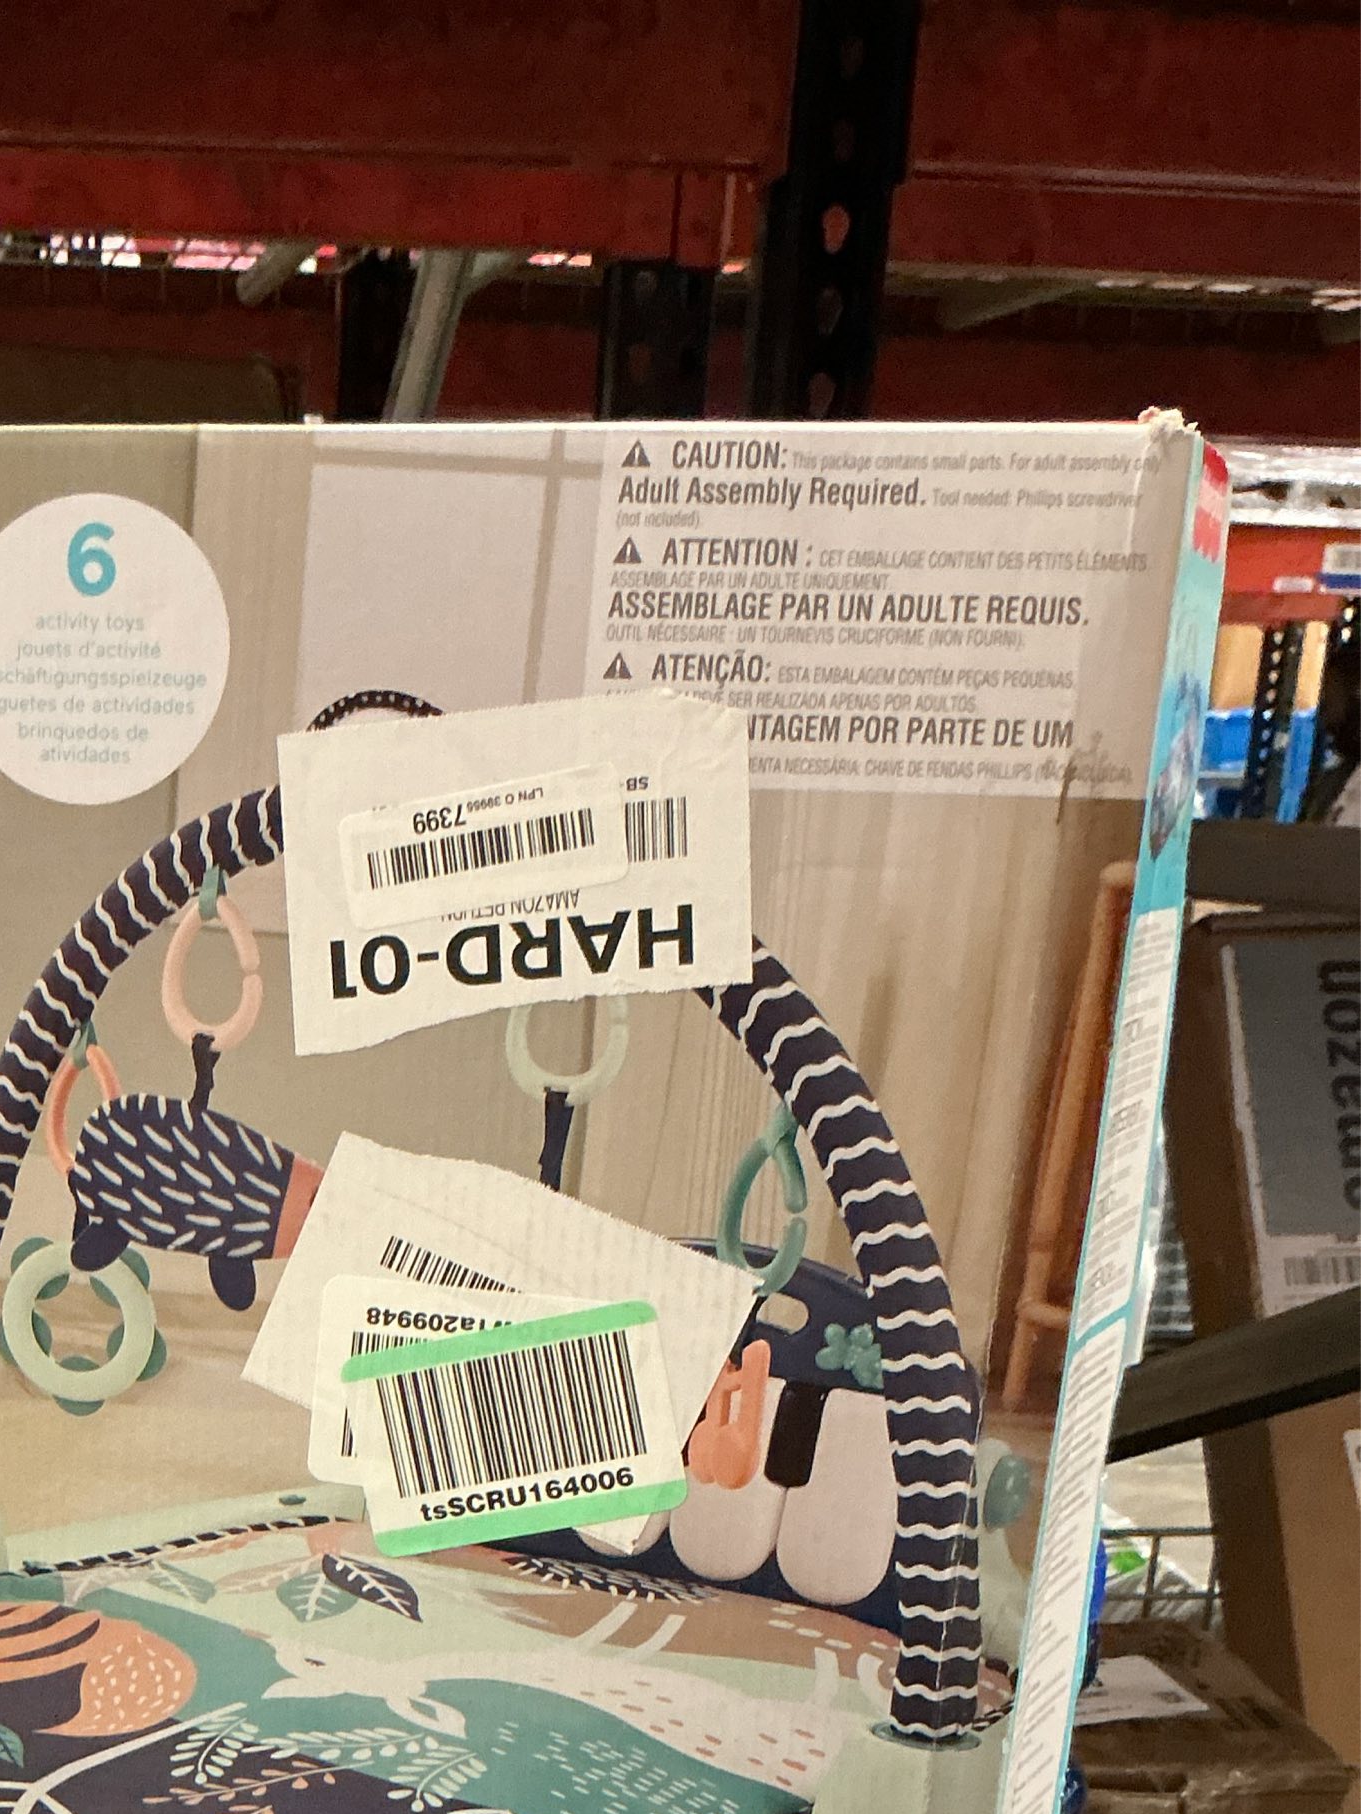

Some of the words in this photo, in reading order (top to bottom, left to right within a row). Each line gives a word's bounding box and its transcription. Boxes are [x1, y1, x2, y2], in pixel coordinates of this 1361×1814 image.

[672, 440, 787, 469] CAUTION:
[875, 454, 928, 470] contains
[933, 454, 966, 470] small
[1009, 452, 1031, 471] For
[1033, 454, 1066, 471] adult
[1070, 454, 1131, 475] assembly
[618, 476, 680, 504] Adult
[686, 476, 802, 511] Assembly
[809, 477, 926, 512] Required.
[67, 521, 116, 597] 6
[662, 537, 799, 567] ATTENTION
[928, 551, 992, 570] CONTIENT
[1026, 551, 1073, 571] PETITS
[35, 612, 99, 634] activity
[106, 613, 144, 635] toys
[607, 591, 773, 620] ASSEMBLAGE
[779, 593, 830, 621] PAR
[838, 593, 873, 622] UN
[879, 594, 980, 624] ADULTE
[986, 596, 1089, 626] REQUIS.
[16, 640, 72, 661] jouets
[651, 649, 772, 688] ATENÇÃO:
[63, 695, 85, 713] de
[91, 695, 194, 716] actividades
[17, 721, 119, 743] brinquedos
[126, 723, 149, 741] de
[748, 714, 839, 743] NTAGEM
[848, 716, 899, 743] POR
[906, 717, 986, 746] PARTE
[992, 719, 1025, 747] DE
[1033, 720, 1074, 748] UM
[40, 746, 130, 764] atividades
[518, 786, 544, 802] LPN
[412, 803, 467, 835] 7399
[330, 903, 694, 999] HARD-01
[421, 1466, 635, 1523] tsSCRU164006
